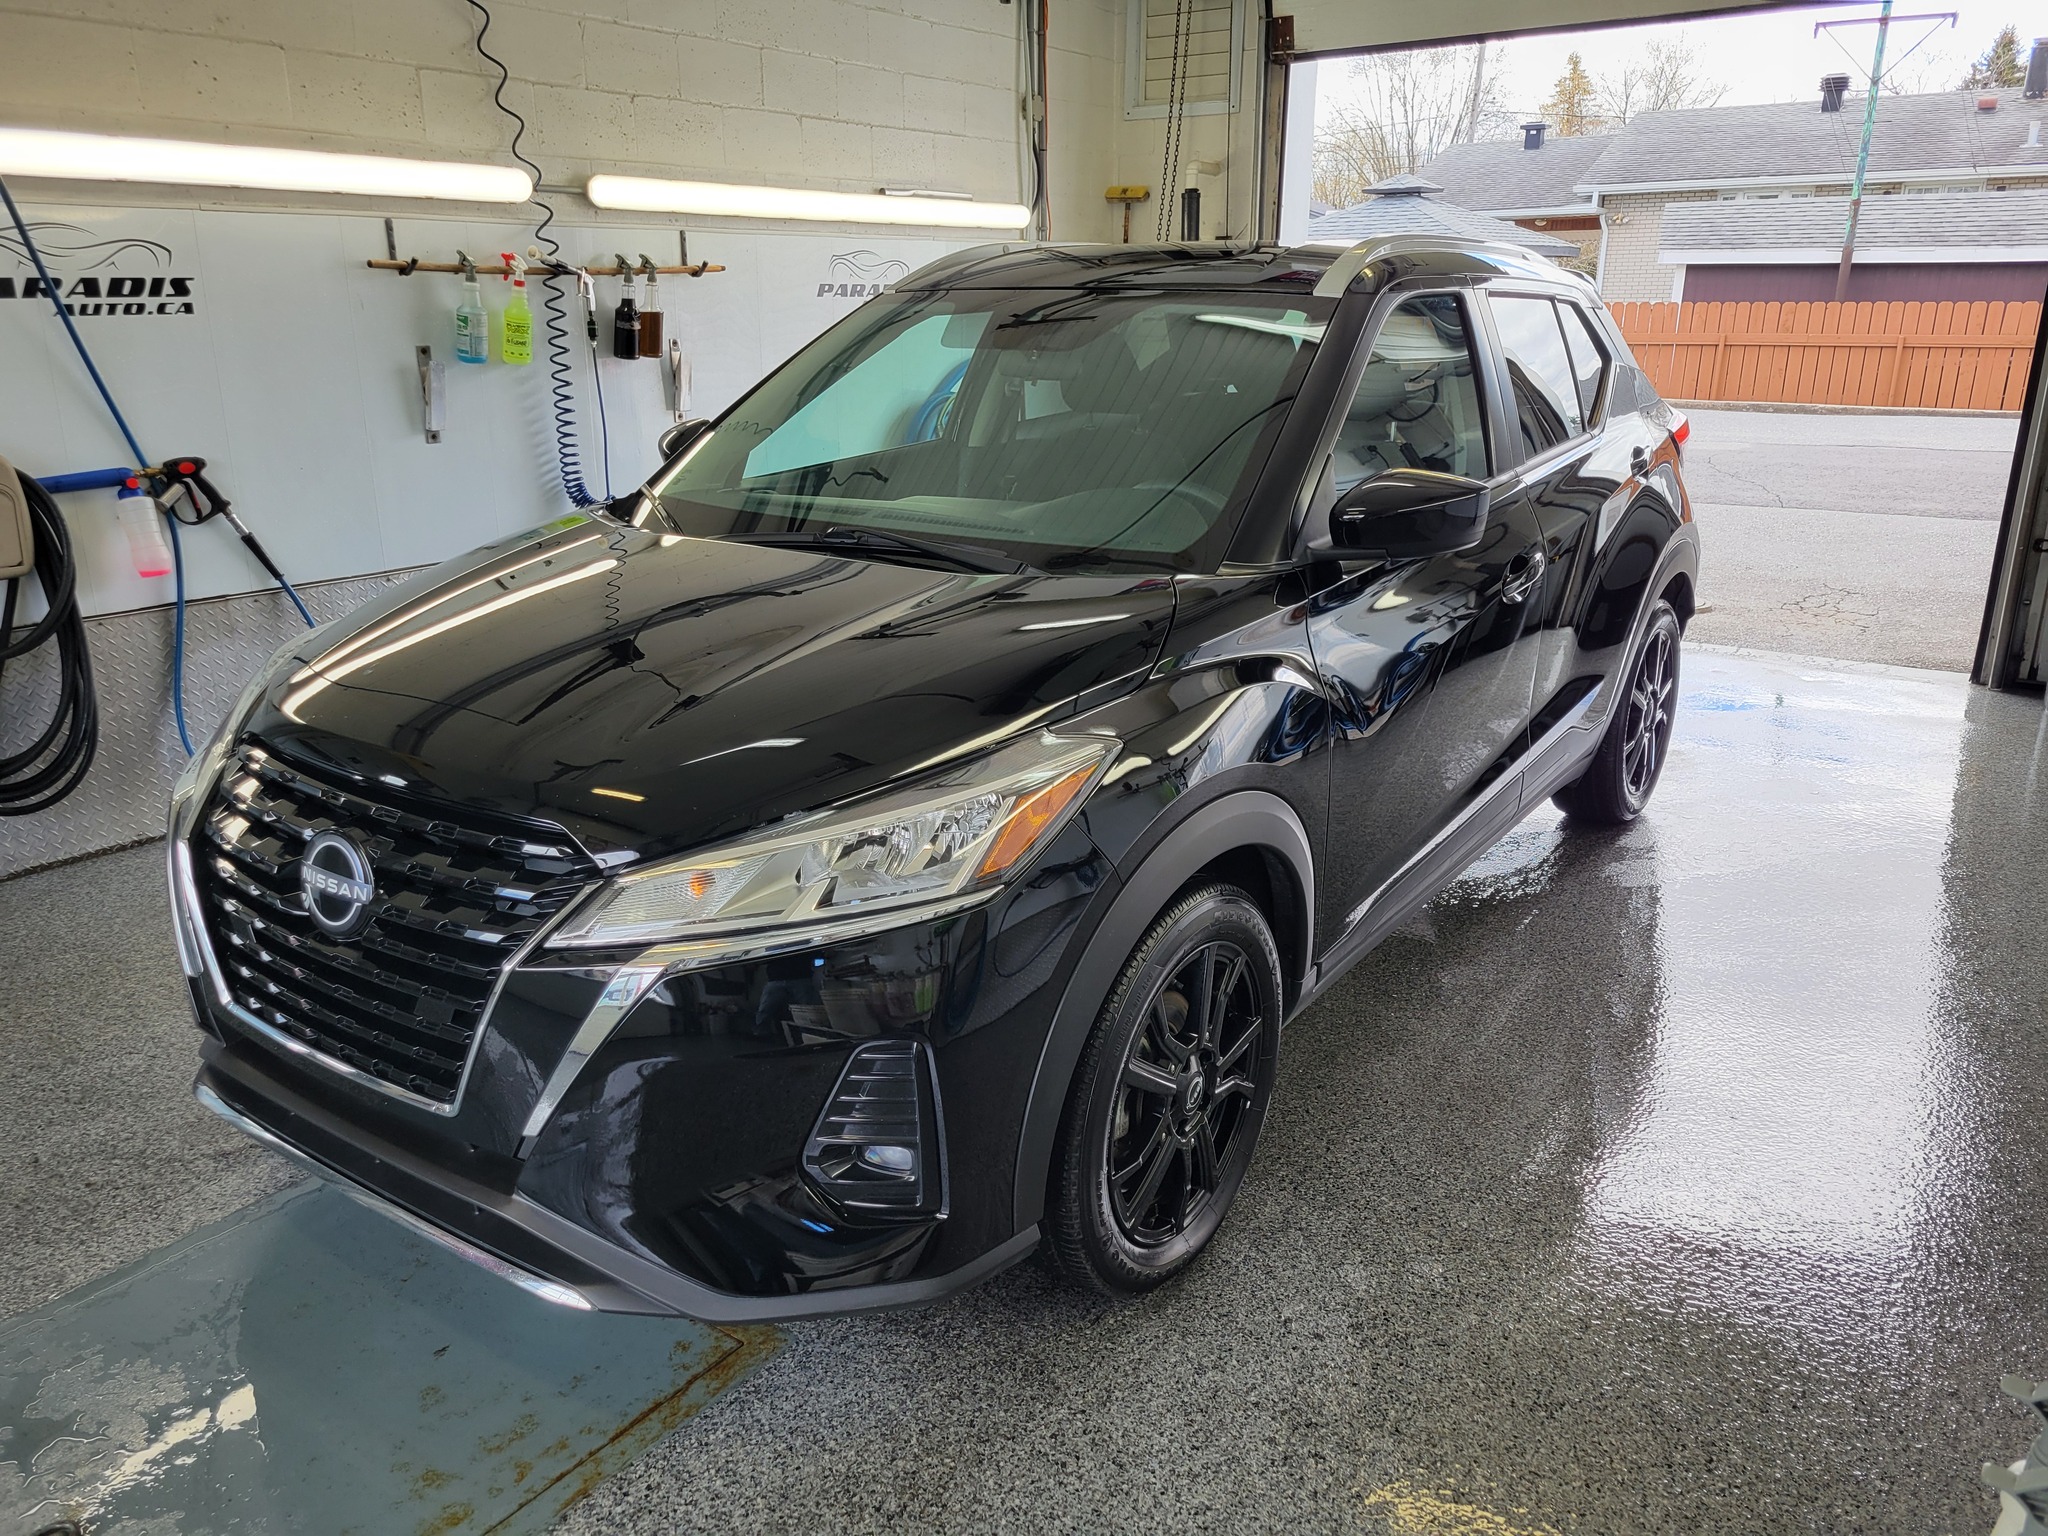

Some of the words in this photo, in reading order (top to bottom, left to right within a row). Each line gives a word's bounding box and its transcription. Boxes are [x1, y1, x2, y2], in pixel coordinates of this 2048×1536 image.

[817, 283, 892, 298] PARA
[54, 302, 195, 316] AUTO.CA
[304, 866, 367, 901] NISSAN
